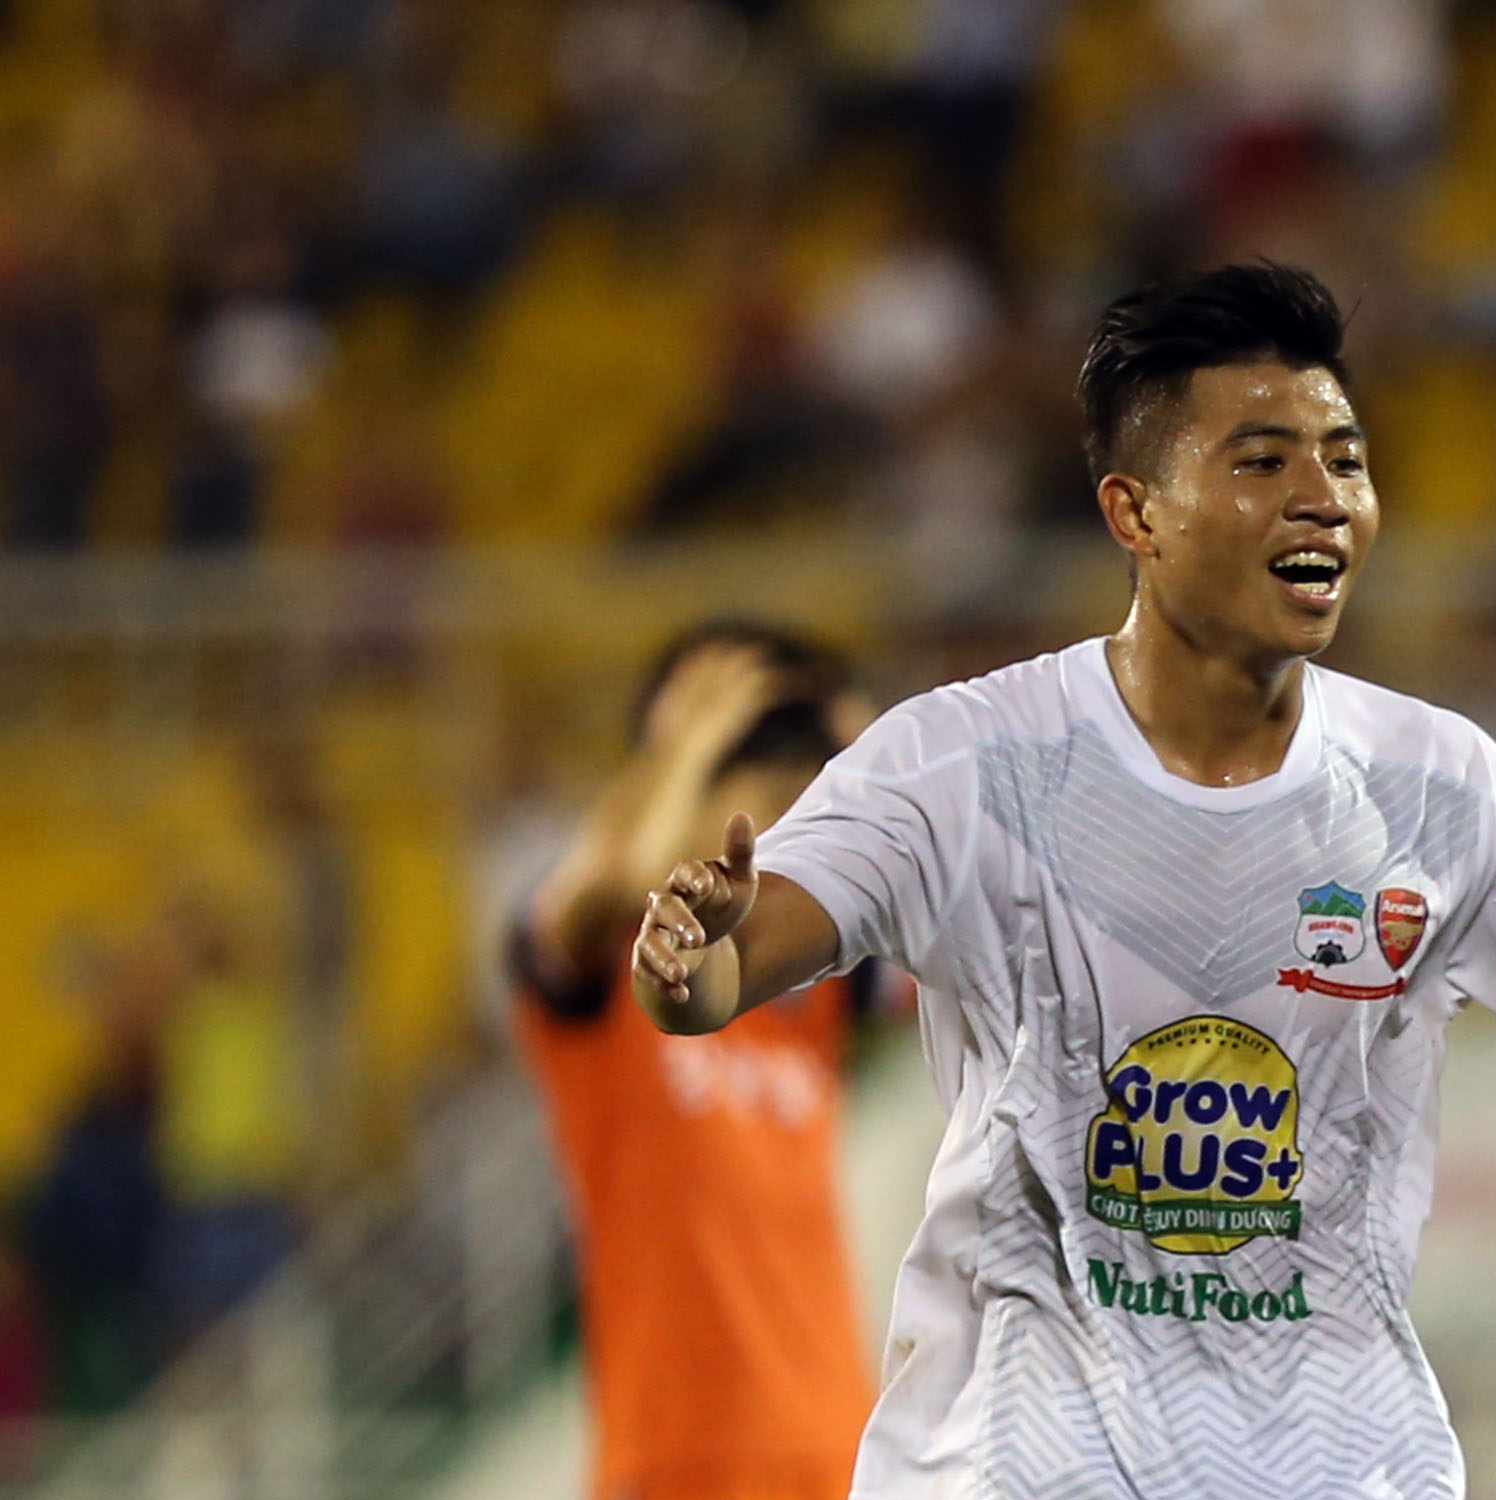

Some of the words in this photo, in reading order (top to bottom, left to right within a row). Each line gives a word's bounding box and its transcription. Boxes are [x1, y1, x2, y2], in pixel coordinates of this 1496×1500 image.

[1148, 1024, 1210, 1050] PREMIUM
[1214, 1024, 1271, 1055] QUALITY
[1108, 1064, 1292, 1132] Grow
[1091, 1194, 1125, 1219] CHO
[1087, 1258, 1314, 1322] NutiFood
